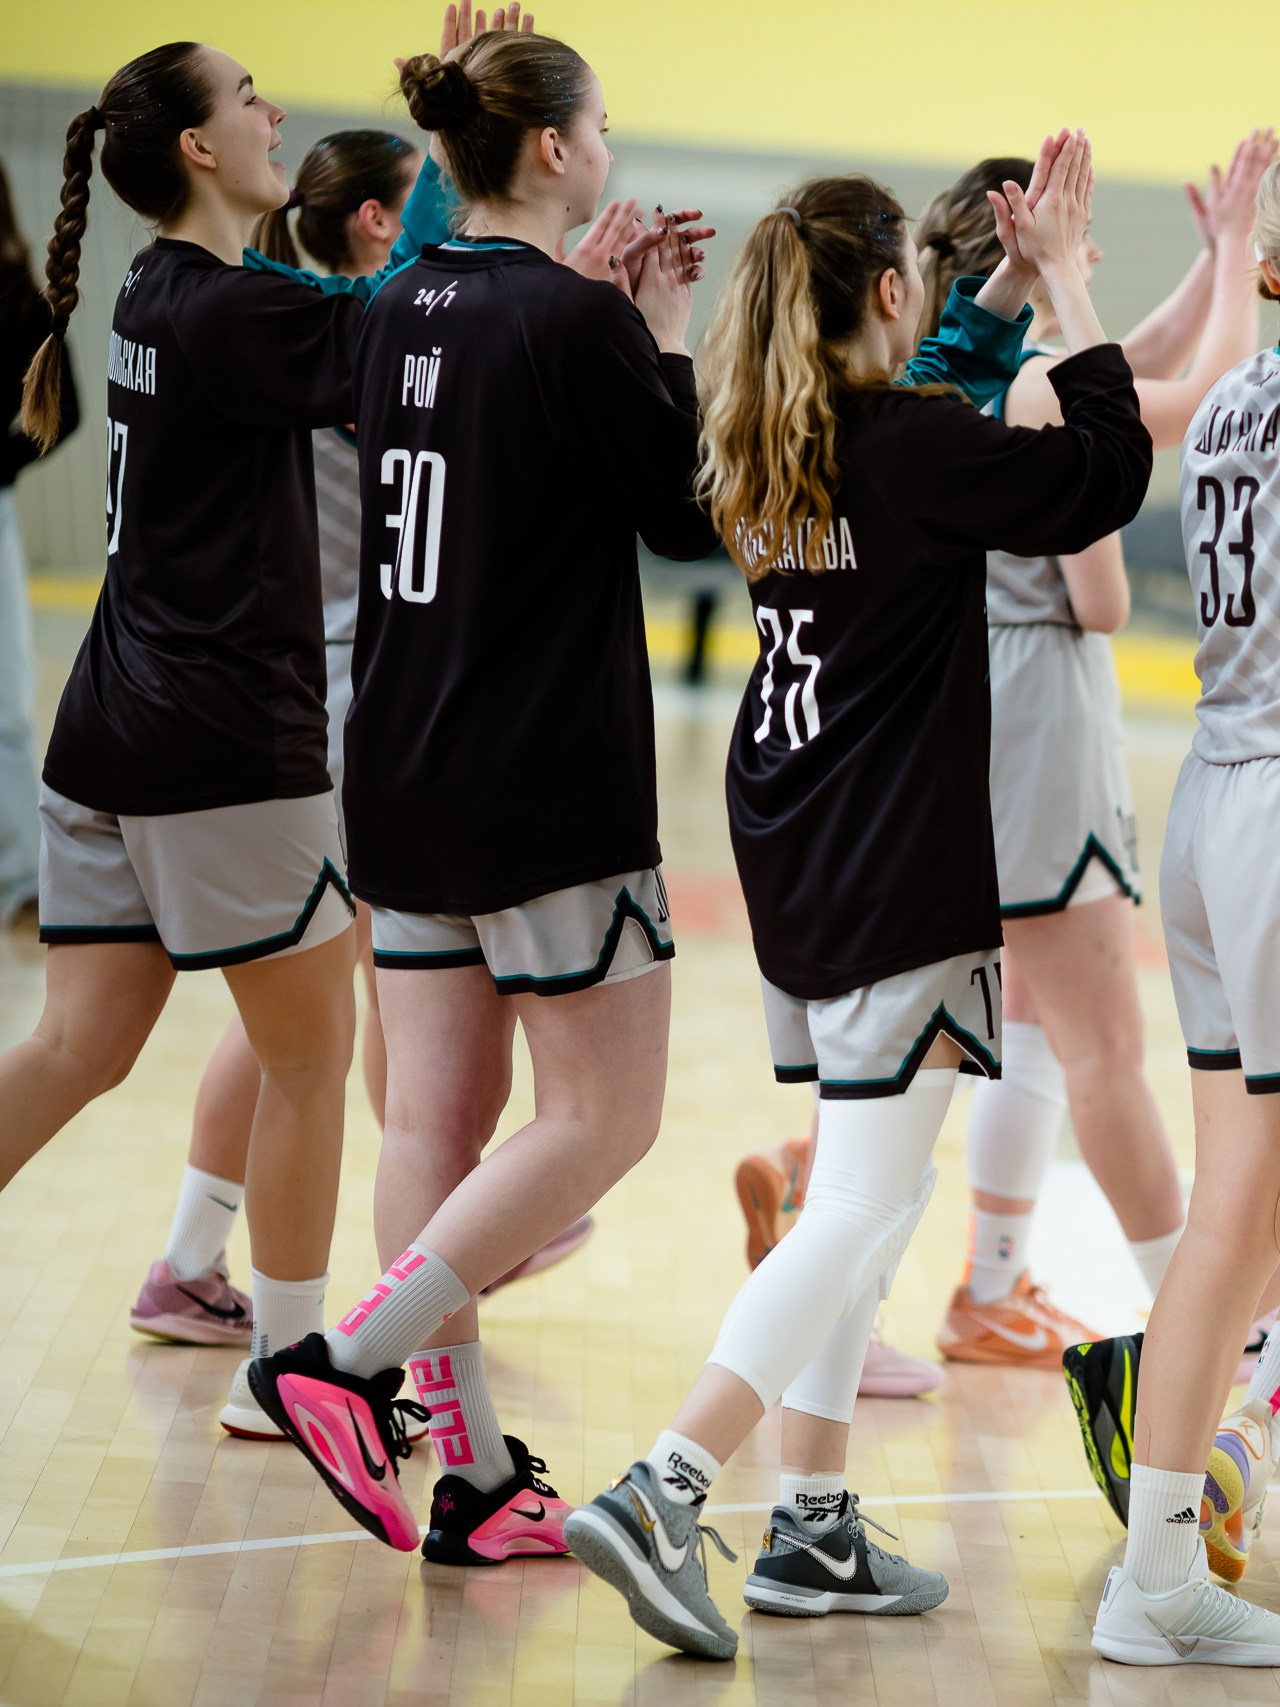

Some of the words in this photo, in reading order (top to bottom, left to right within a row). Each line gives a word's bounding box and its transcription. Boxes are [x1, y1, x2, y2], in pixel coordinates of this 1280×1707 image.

[413, 280, 459, 316] 24/7
[401, 346, 443, 409] РОЙ
[379, 448, 447, 604] 30
[1197, 475, 1261, 627] 33
[754, 604, 821, 751] 75
[970, 961, 1002, 1040] 7
